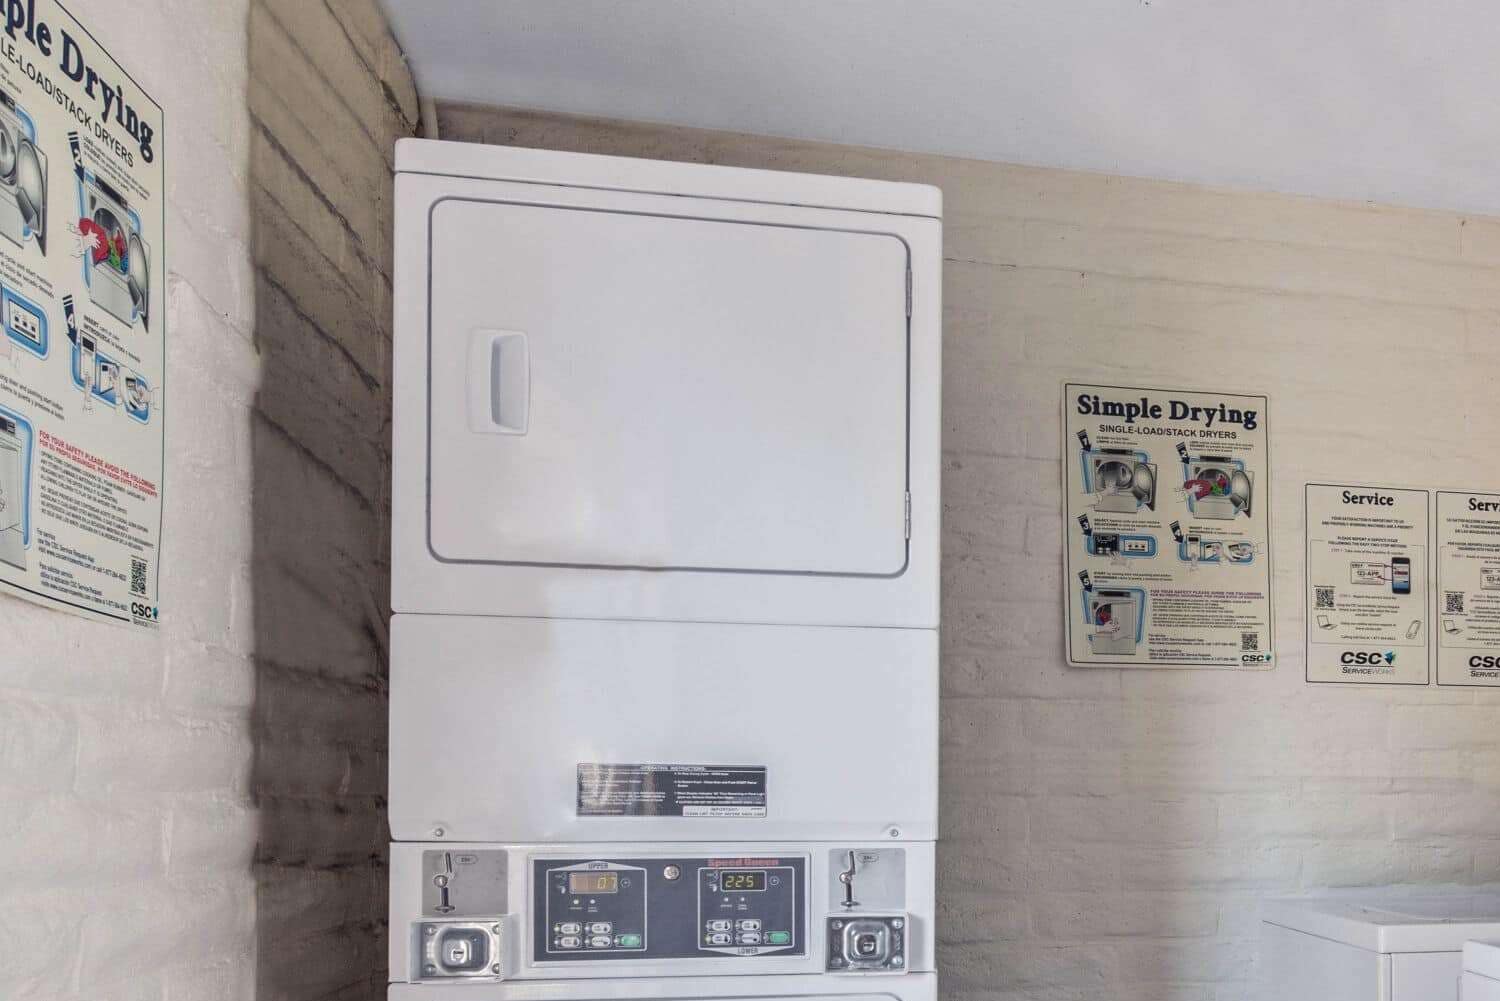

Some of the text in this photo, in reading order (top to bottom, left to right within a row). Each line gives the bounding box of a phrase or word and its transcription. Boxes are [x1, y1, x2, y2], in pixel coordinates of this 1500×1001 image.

[0, 0, 154, 164] ple Drying
[94, 121, 134, 168] DRYERS
[73, 149, 82, 166] 2
[66, 313, 75, 328] 4
[1077, 394, 1258, 430] Simple Drying
[1098, 424, 1237, 439] SINGLE-LOAD/STACK DRYERS
[1342, 490, 1395, 507] Service
[131, 602, 152, 618] CSC
[1241, 654, 1264, 662] CSC
[1340, 651, 1382, 665] CSC
[725, 875, 755, 889] 225
[737, 947, 759, 955] LOWER
